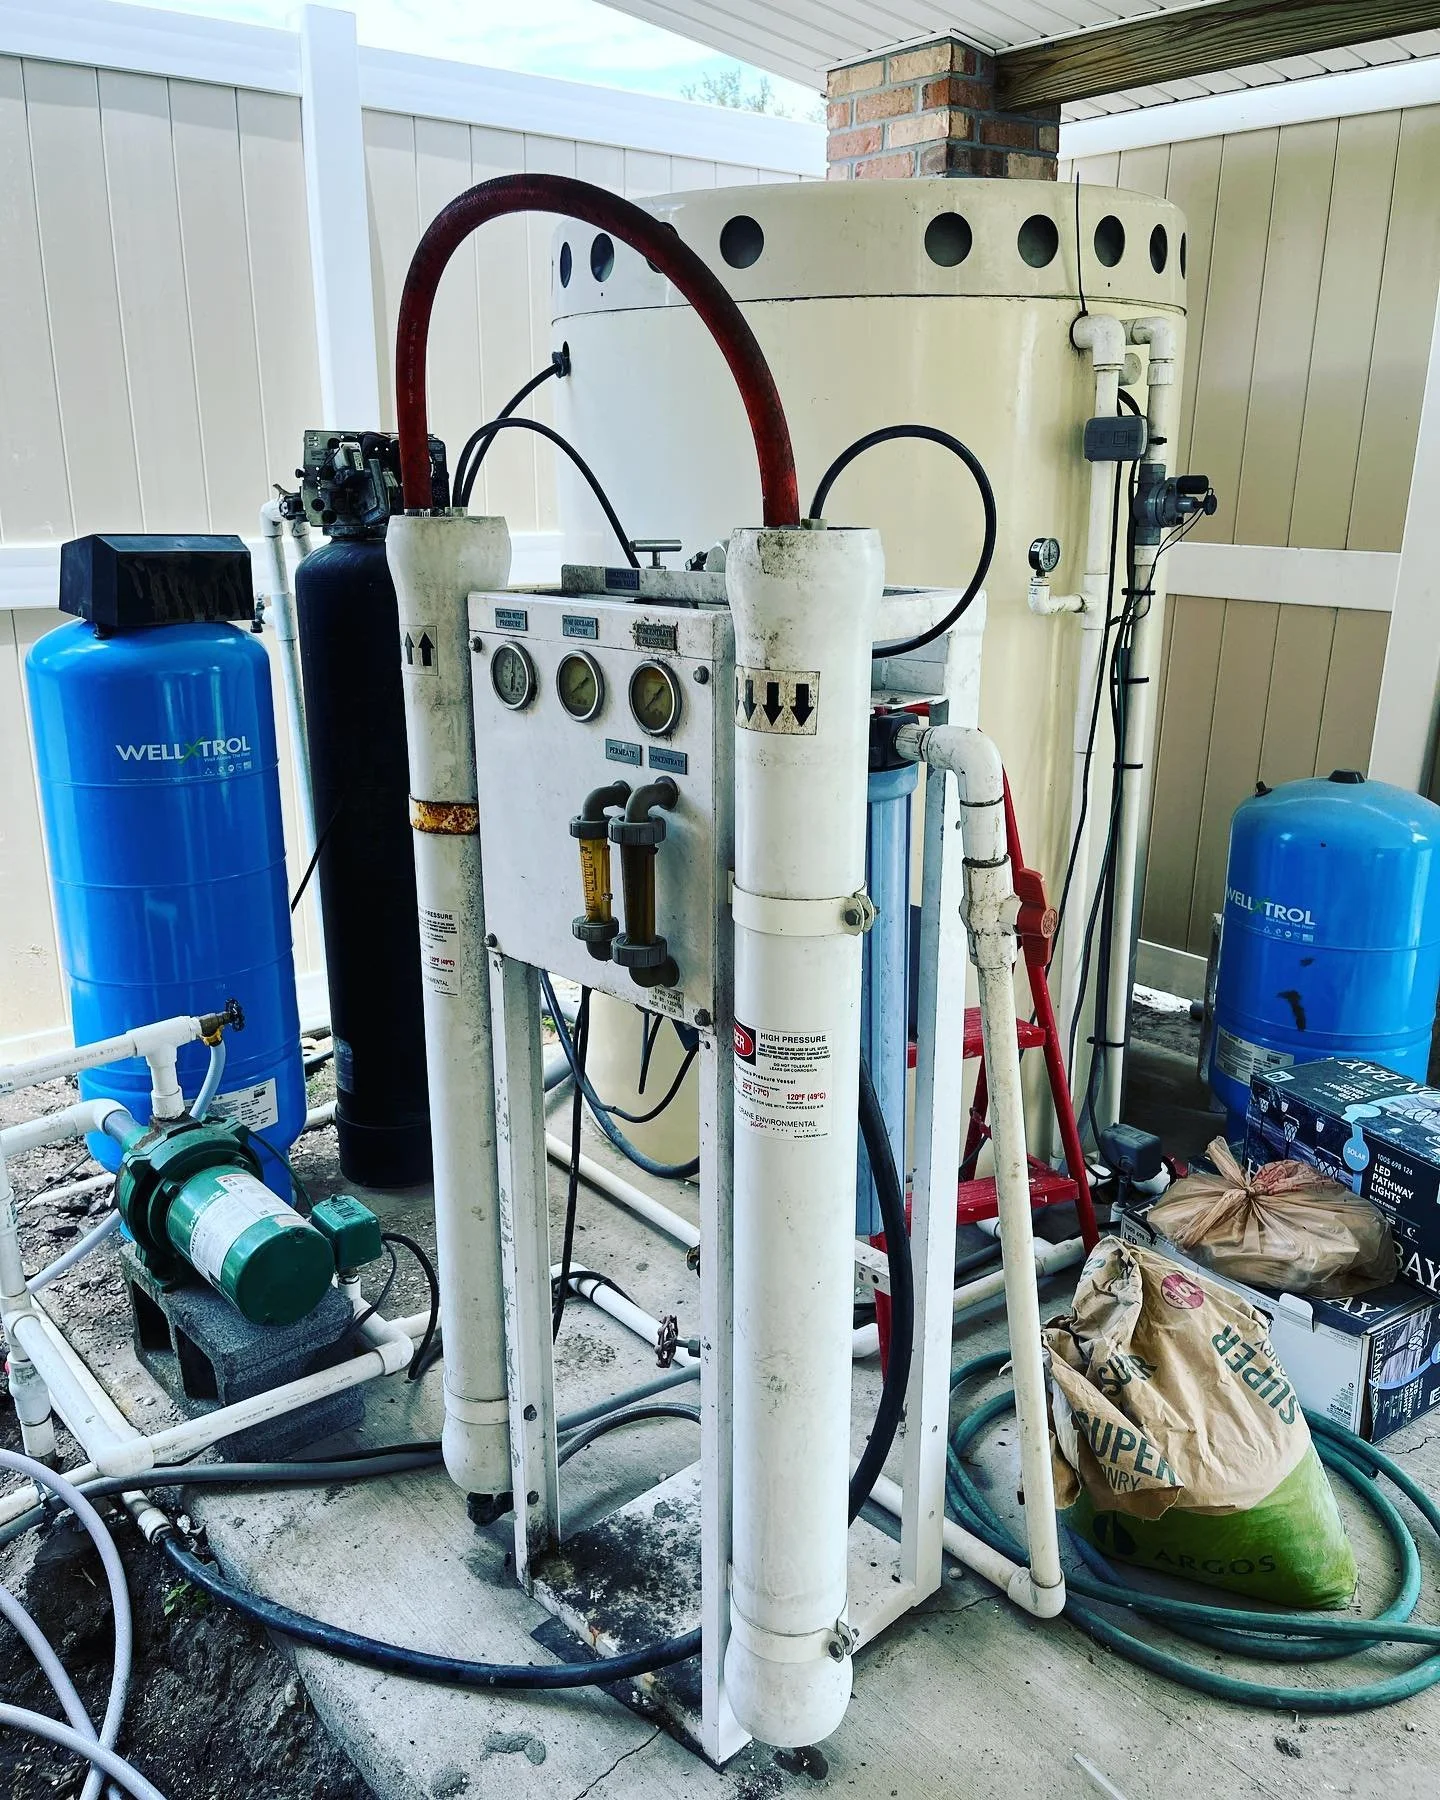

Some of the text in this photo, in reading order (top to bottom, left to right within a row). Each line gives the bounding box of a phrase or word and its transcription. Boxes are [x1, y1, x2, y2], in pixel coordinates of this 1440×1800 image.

[499, 619, 522, 628] PRESSURE
[609, 746, 636, 758] PERMEATE
[650, 754, 685, 767] CONCENTRATE
[760, 1032, 826, 1044] HIGH PRESSURE
[755, 1115, 818, 1128] ENVIRONMENTAL
[1346, 1147, 1366, 1160] SOLAR
[1374, 1162, 1391, 1177] LED
[1377, 1153, 1391, 1165] 1005
[1402, 1166, 1414, 1176] 124
[1370, 1182, 1402, 1204] LIGHTS
[1372, 1172, 1414, 1200] PATHWAY
[1382, 1200, 1397, 1212] FINISH
[1123, 1231, 1138, 1245] LED
[1211, 1324, 1297, 1425] SUPER
[1406, 1382, 1416, 1419] PATHWAY
[1153, 1548, 1277, 1576] ARGOS
